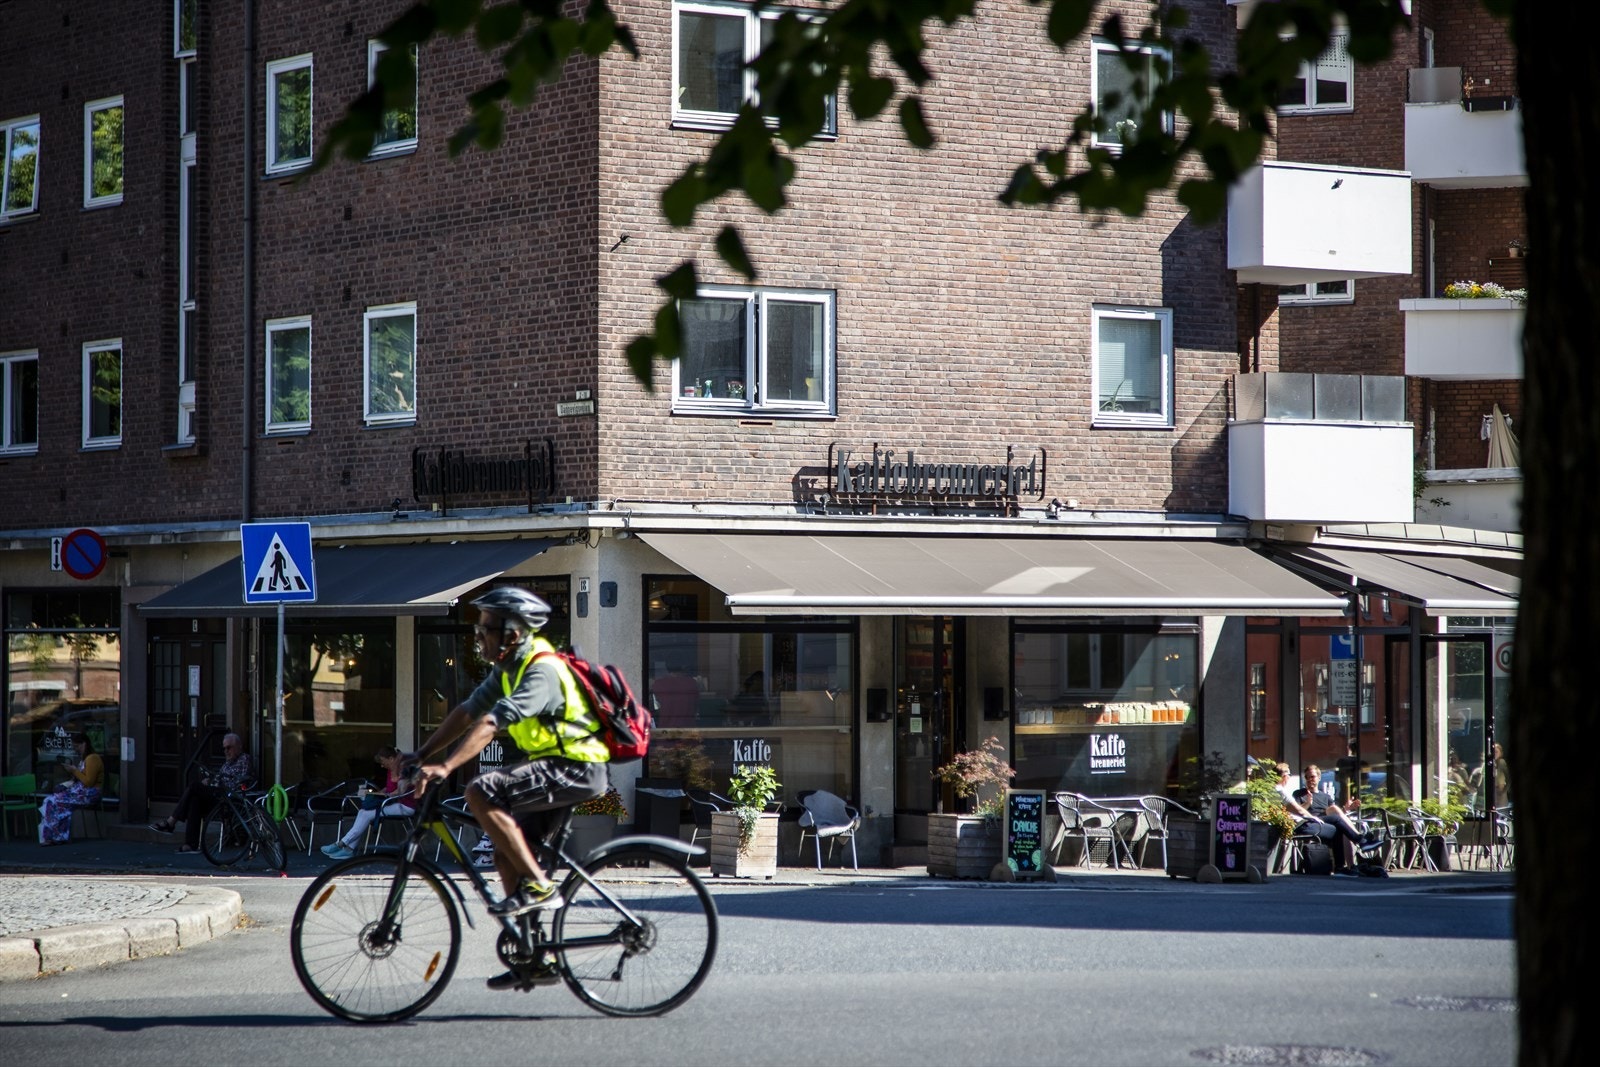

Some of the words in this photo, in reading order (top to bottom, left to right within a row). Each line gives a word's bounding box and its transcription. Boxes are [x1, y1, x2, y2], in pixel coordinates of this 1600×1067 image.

[416, 446, 549, 496] Kaffebrenneriet
[836, 449, 1040, 496] Kaffebrenneriet
[733, 739, 772, 762] Kaffe
[1090, 734, 1126, 756] Kaffe
[1090, 756, 1126, 768] brenneriet
